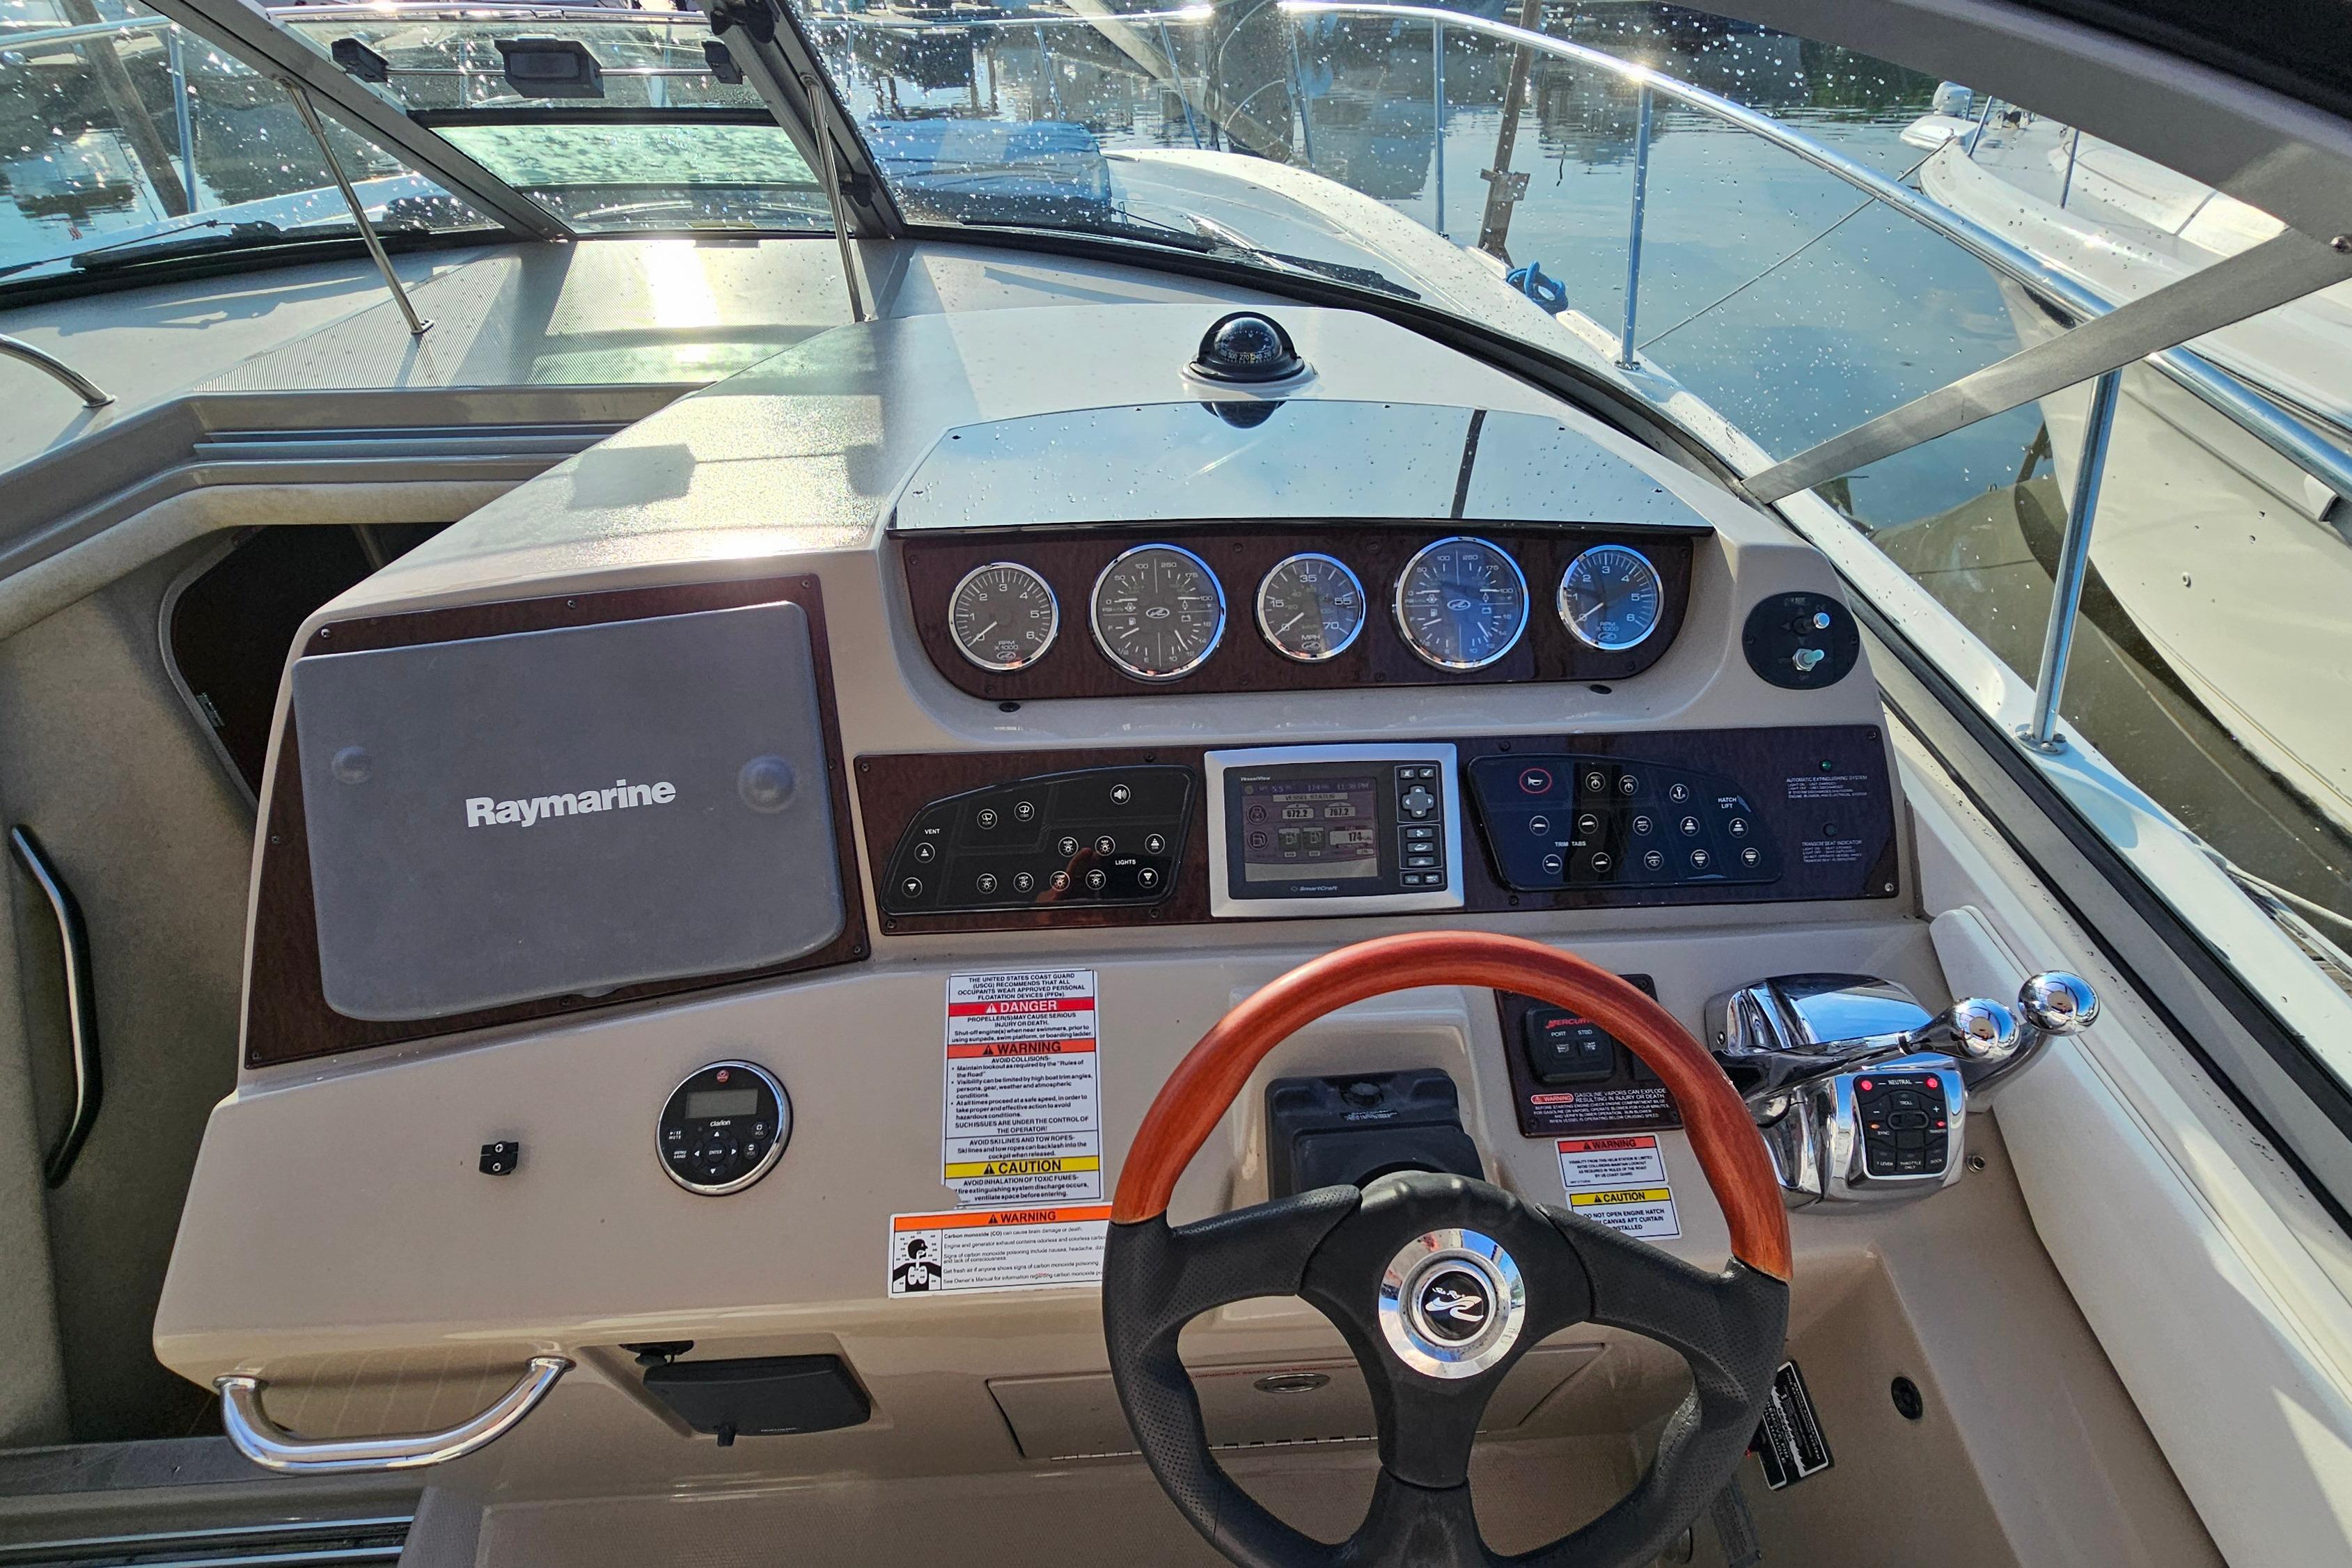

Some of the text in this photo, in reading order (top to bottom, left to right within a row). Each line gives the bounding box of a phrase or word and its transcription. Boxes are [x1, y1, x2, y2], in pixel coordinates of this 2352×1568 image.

[998, 583, 1008, 592] 3
[979, 593, 988, 602] 2
[976, 634, 985, 642] 0
[1026, 631, 1035, 639] 6
[466, 778, 677, 827] Raymarine
[1000, 1000, 1057, 1012] DANGER
[997, 1041, 1060, 1054] WARNING
[1592, 1139, 1636, 1149] WARNING
[998, 1159, 1061, 1173] CAUTION
[1603, 1192, 1645, 1202] CAUTION
[1000, 1211, 1056, 1223] WARNING
